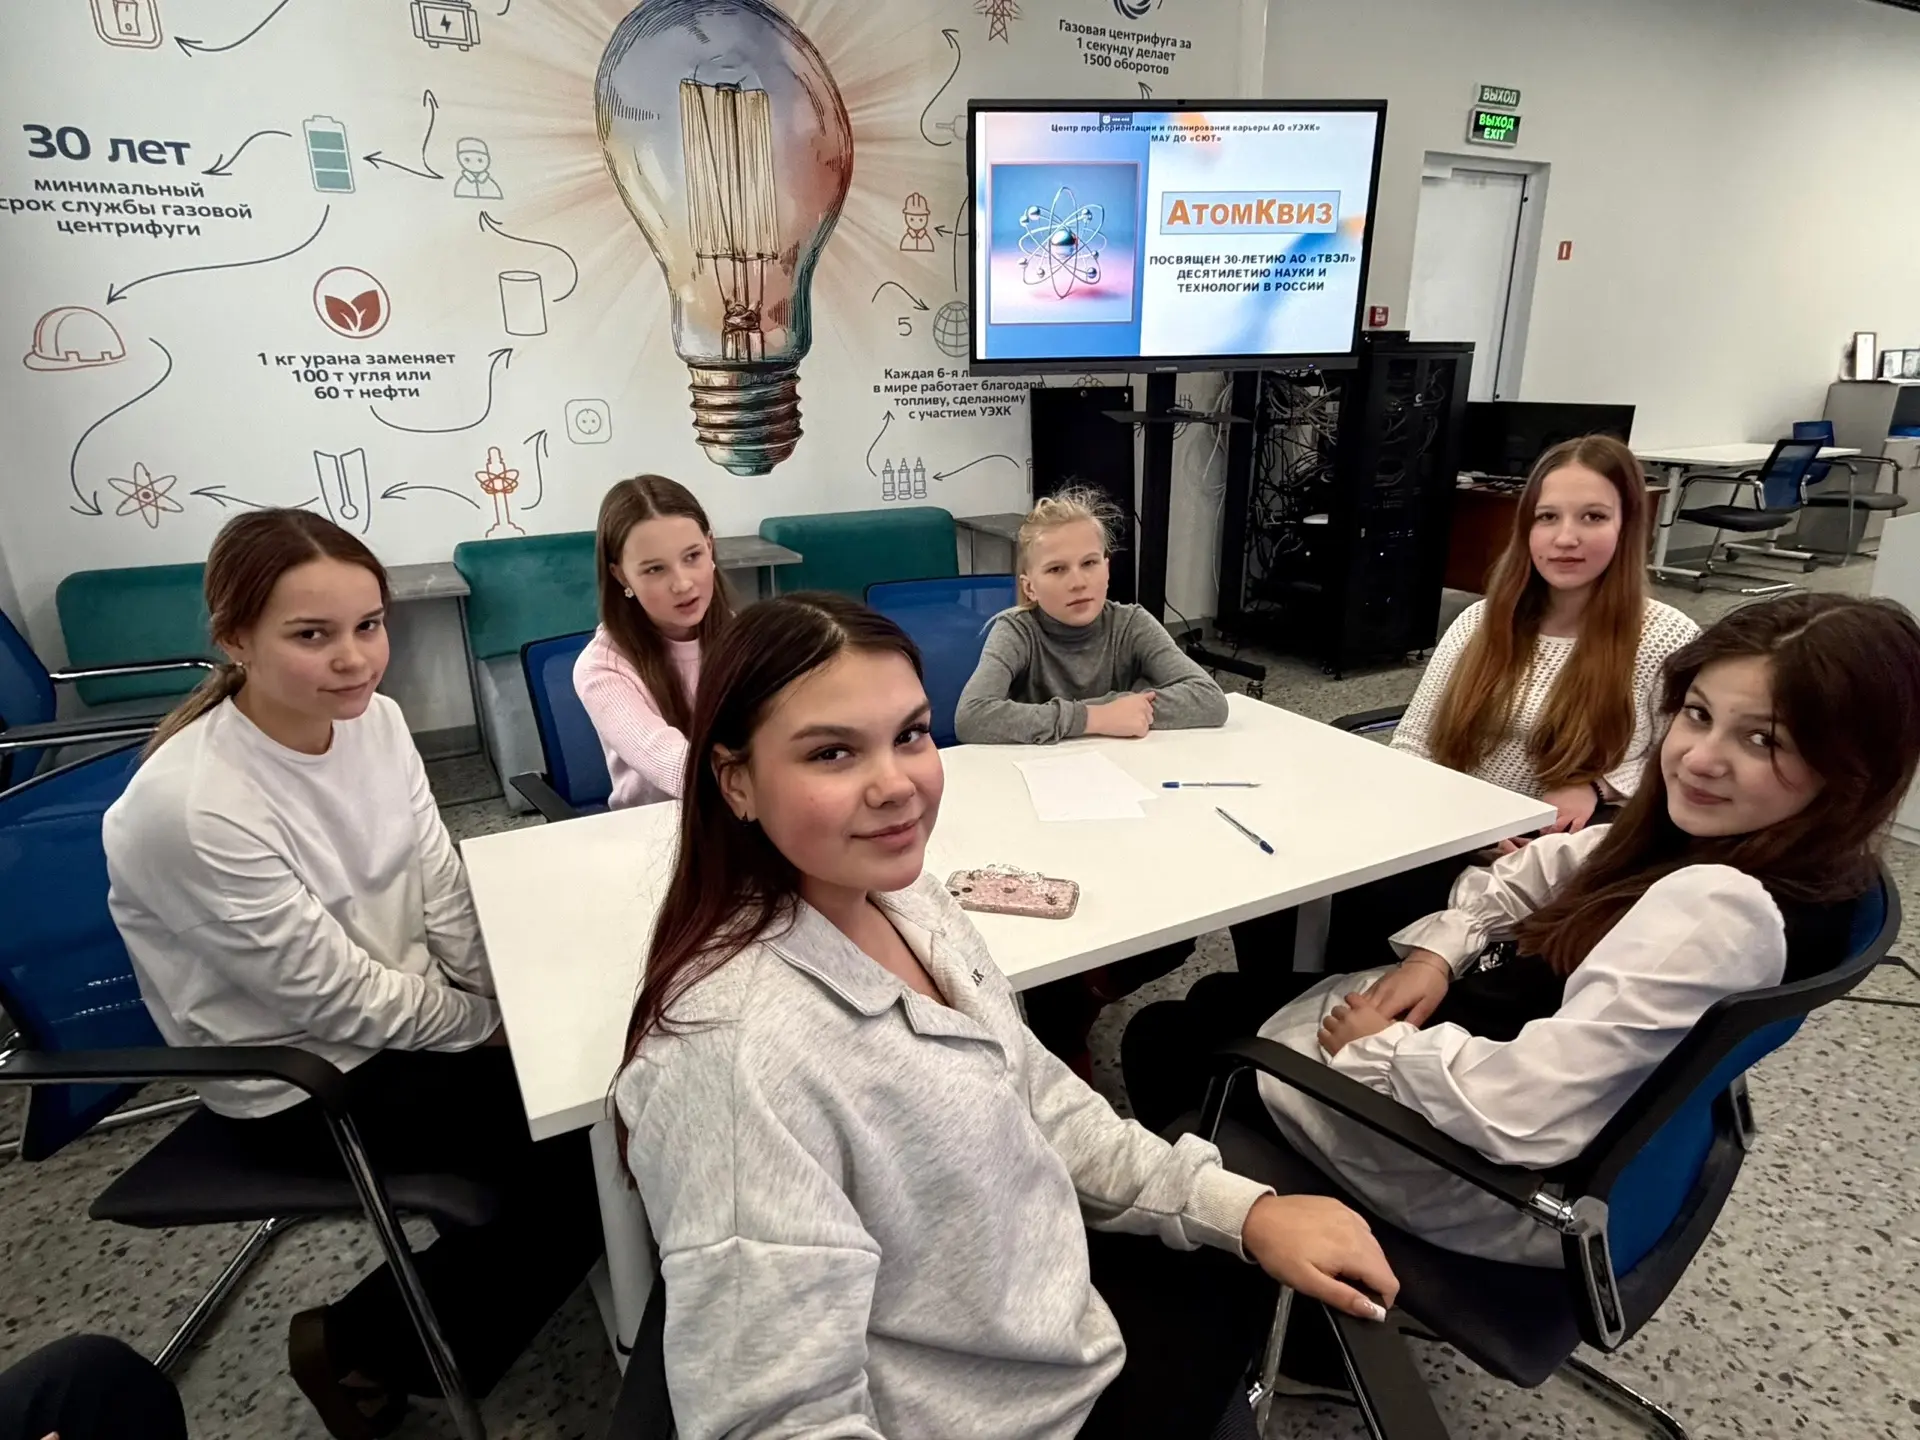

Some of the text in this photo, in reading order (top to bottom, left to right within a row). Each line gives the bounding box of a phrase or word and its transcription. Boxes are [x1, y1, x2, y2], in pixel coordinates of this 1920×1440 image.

[1059, 19, 1192, 49] Газовая центрифуга за
[1076, 37, 1176, 61] 1 секунду делает
[1083, 52, 1169, 75] 1500 оборотов
[1482, 87, 1517, 105] ВЫХОД
[1051, 124, 1078, 133] Центр
[1081, 124, 1157, 133] профориентации
[1479, 113, 1515, 131] ВЫХОД
[1173, 135, 1187, 143] ДО
[1190, 134, 1221, 142] «СЮТ»
[1483, 127, 1506, 140] EXIT
[23, 123, 191, 166] 30 лет
[34, 179, 205, 198] минимальный
[61, 198, 156, 217] службы
[162, 202, 253, 219] газовой
[57, 219, 201, 239] центрифуги
[1149, 253, 1356, 266] ПОСВЯЩЕН 30-ЛЕТИЮ АО «ТВЭЛ»
[1176, 267, 1326, 280] ДЕСЯТИЛЕТИЮ НАУКИ И
[1177, 281, 1325, 293] ТЕХНОЛОГИИ В РОССИИ
[257, 352, 455, 369] 1 кг урана заменяет
[292, 369, 431, 385] 100 т угля или
[884, 368, 934, 380] Каждая
[937, 368, 958, 378] 6-я
[314, 384, 420, 401] 60 т нефти
[873, 385, 881, 393] в
[884, 383, 918, 395] мире
[920, 381, 978, 395] работает
[894, 393, 1026, 407] топливу, сделанному
[908, 406, 1012, 421] с участием УЭХК
